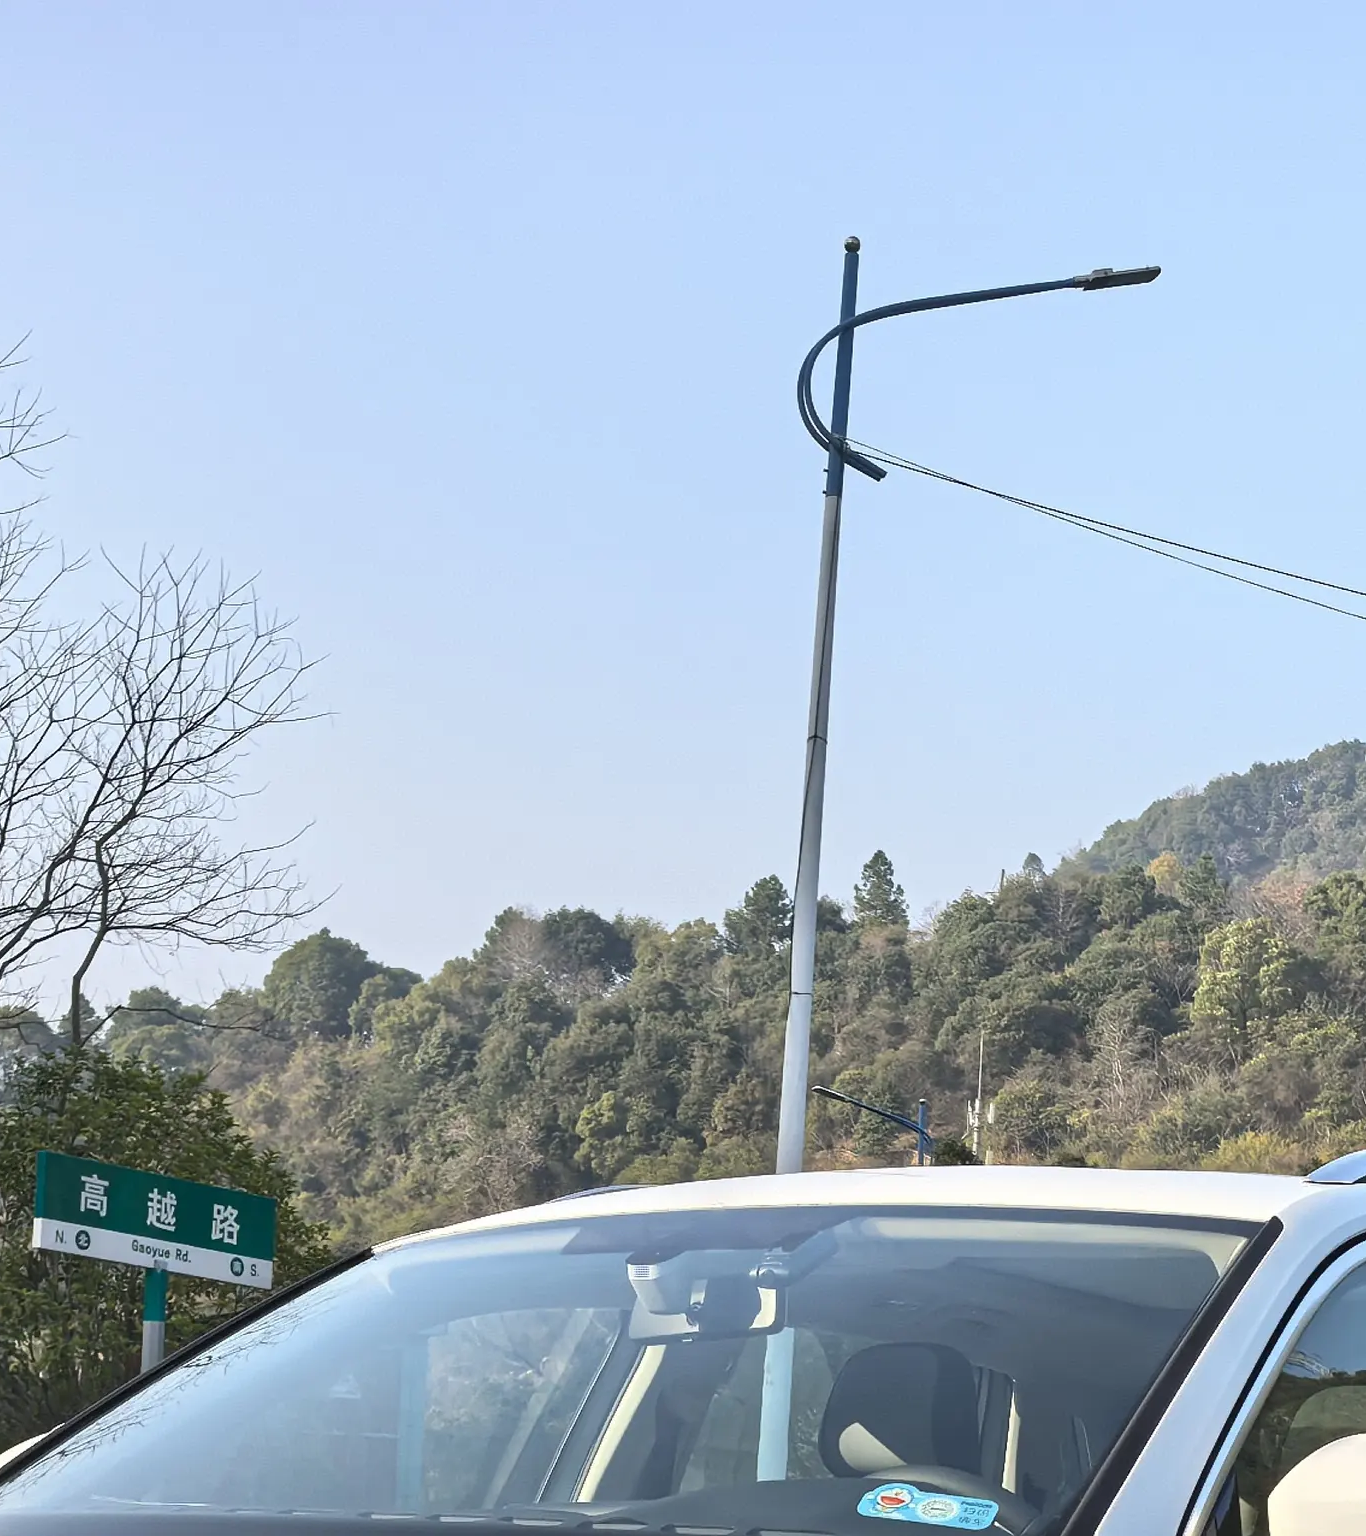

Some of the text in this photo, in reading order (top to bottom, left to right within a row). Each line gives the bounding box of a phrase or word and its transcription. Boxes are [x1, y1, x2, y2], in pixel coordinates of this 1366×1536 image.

[79, 1174, 240, 1246] 高越路
[55, 1229, 67, 1244] N.
[131, 1239, 192, 1263] Gaoyue Rd.
[250, 1264, 260, 1277] S.
